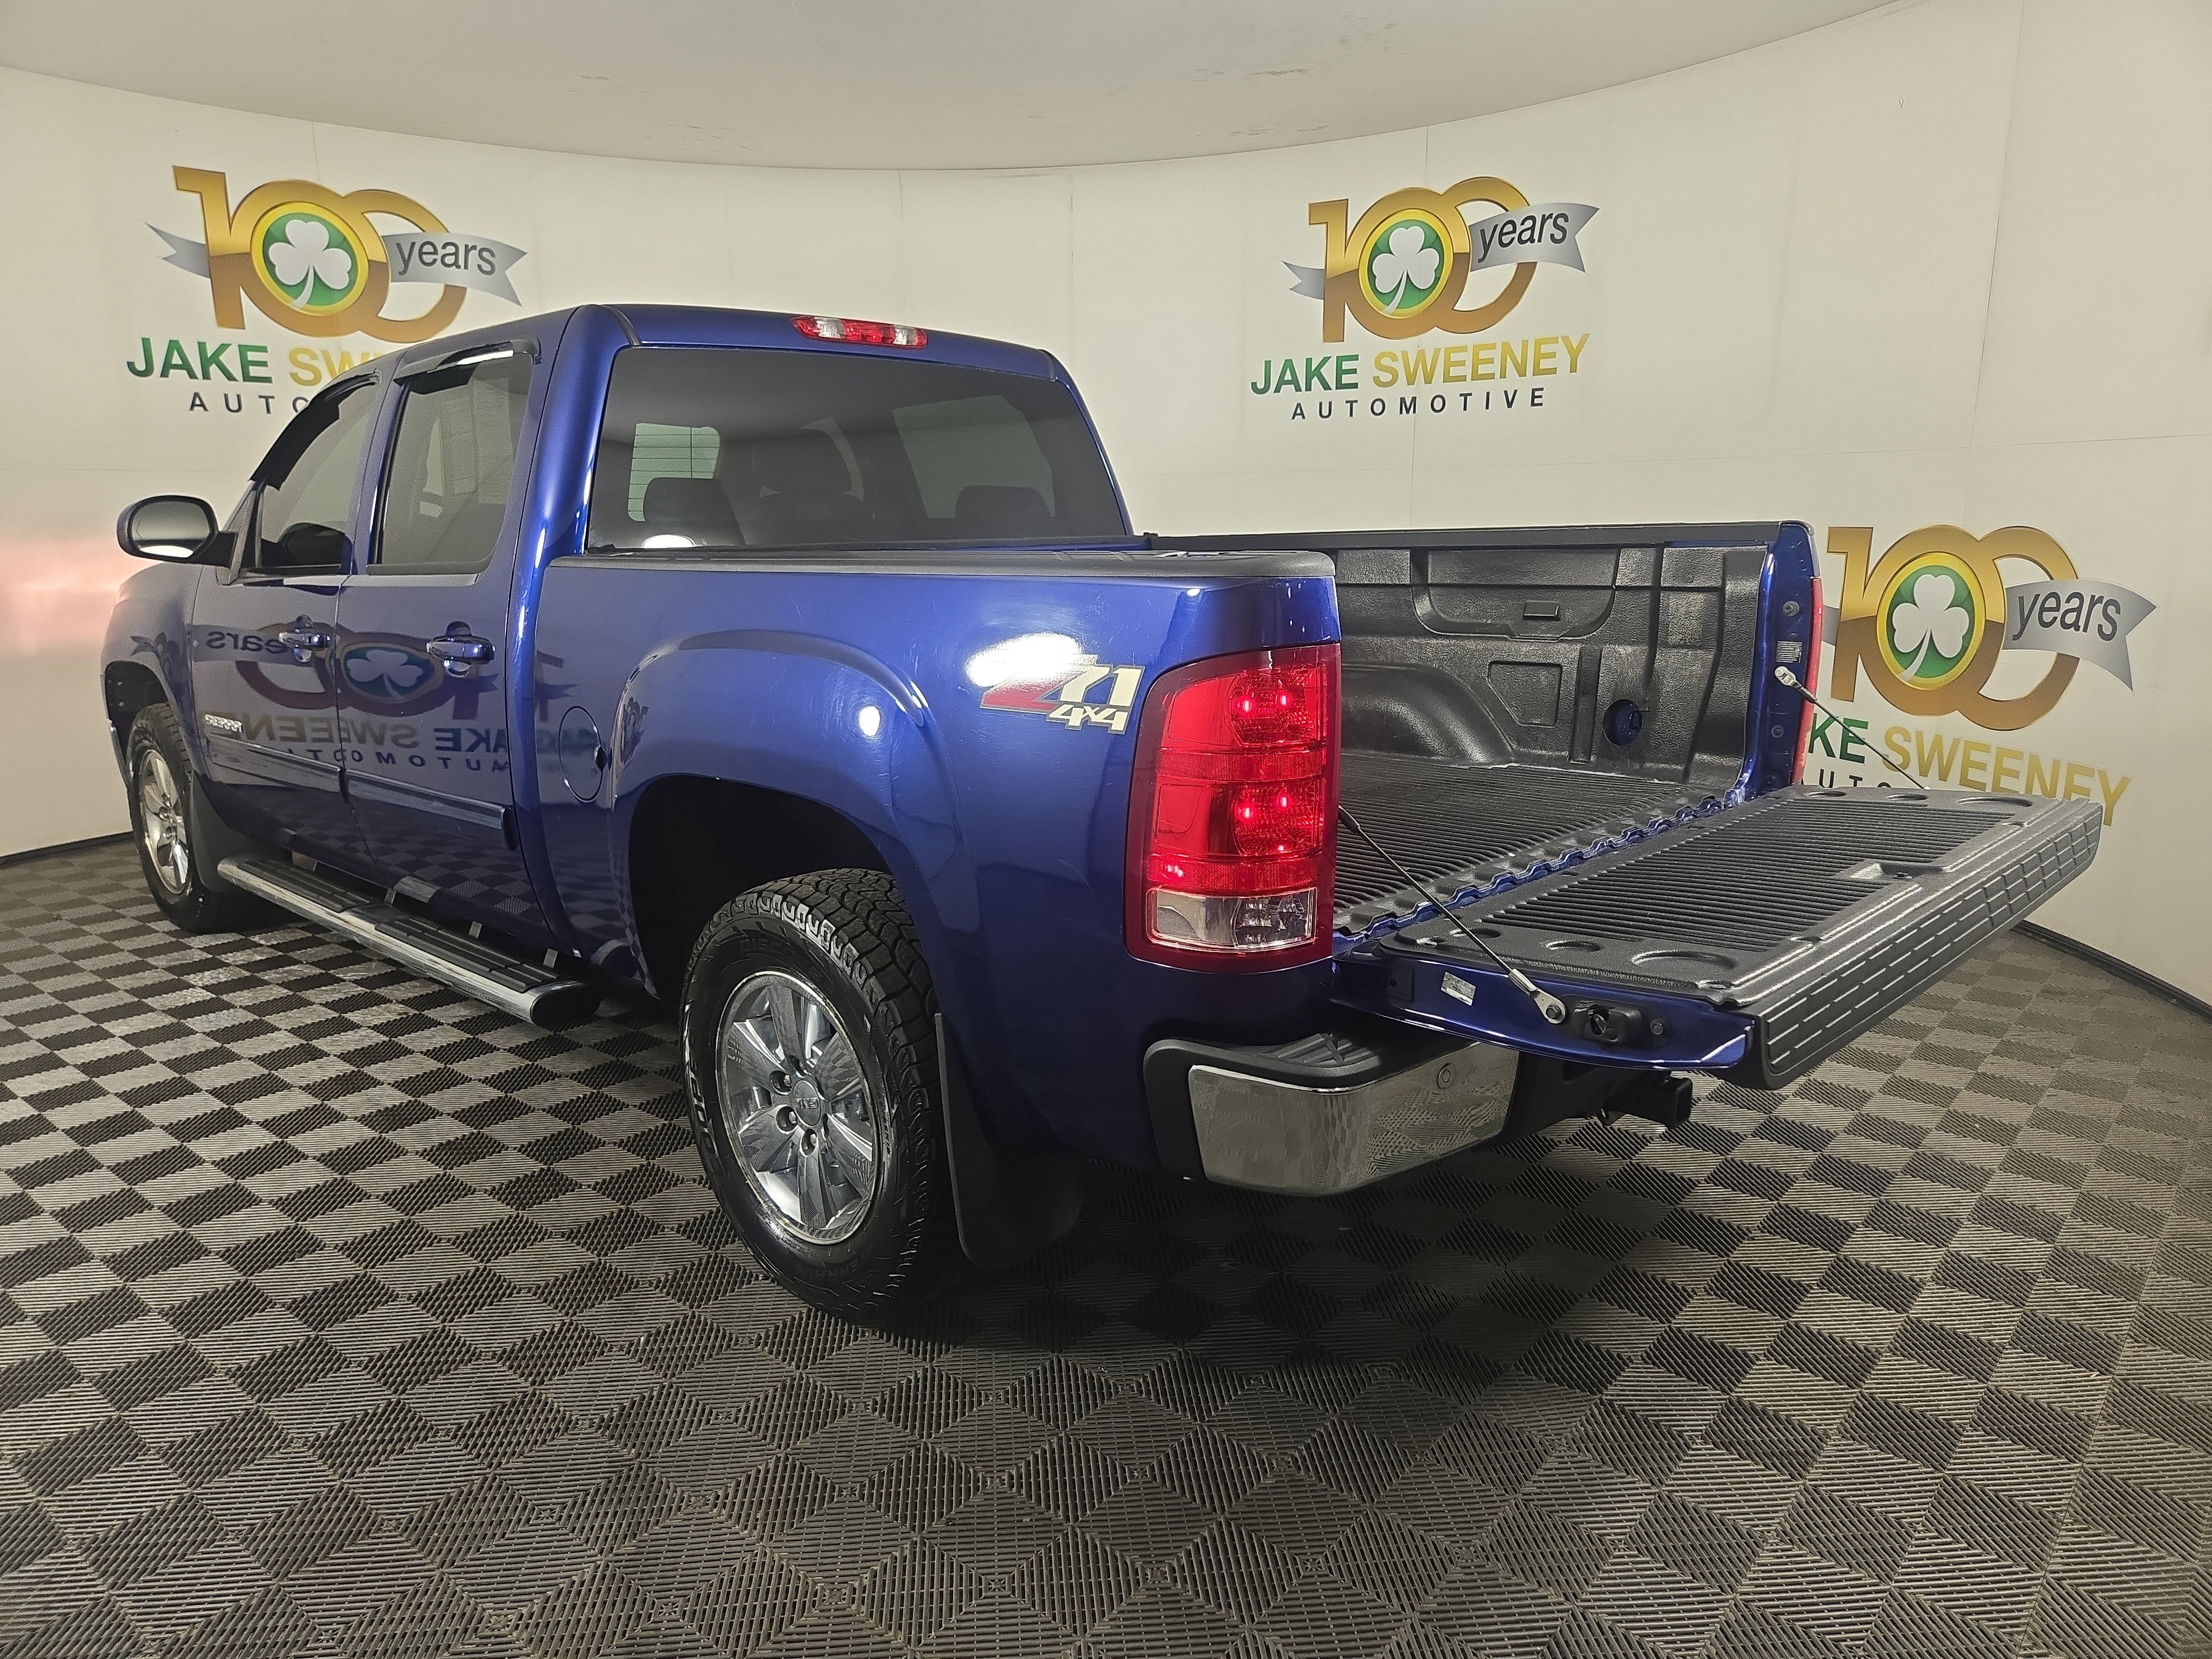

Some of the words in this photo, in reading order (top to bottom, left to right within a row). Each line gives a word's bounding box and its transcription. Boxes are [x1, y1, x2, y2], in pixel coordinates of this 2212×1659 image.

[395, 240, 497, 276] years
[1478, 211, 1569, 263] years
[126, 337, 273, 384] JAKE
[1250, 353, 1359, 395] JAKE
[1372, 333, 1591, 388] SWEENEY
[1291, 387, 1544, 420] AUTOMOTIVE
[2012, 591, 2121, 641] years
[1808, 713, 1869, 764] KE
[1881, 725, 2131, 827] SWEENEY
